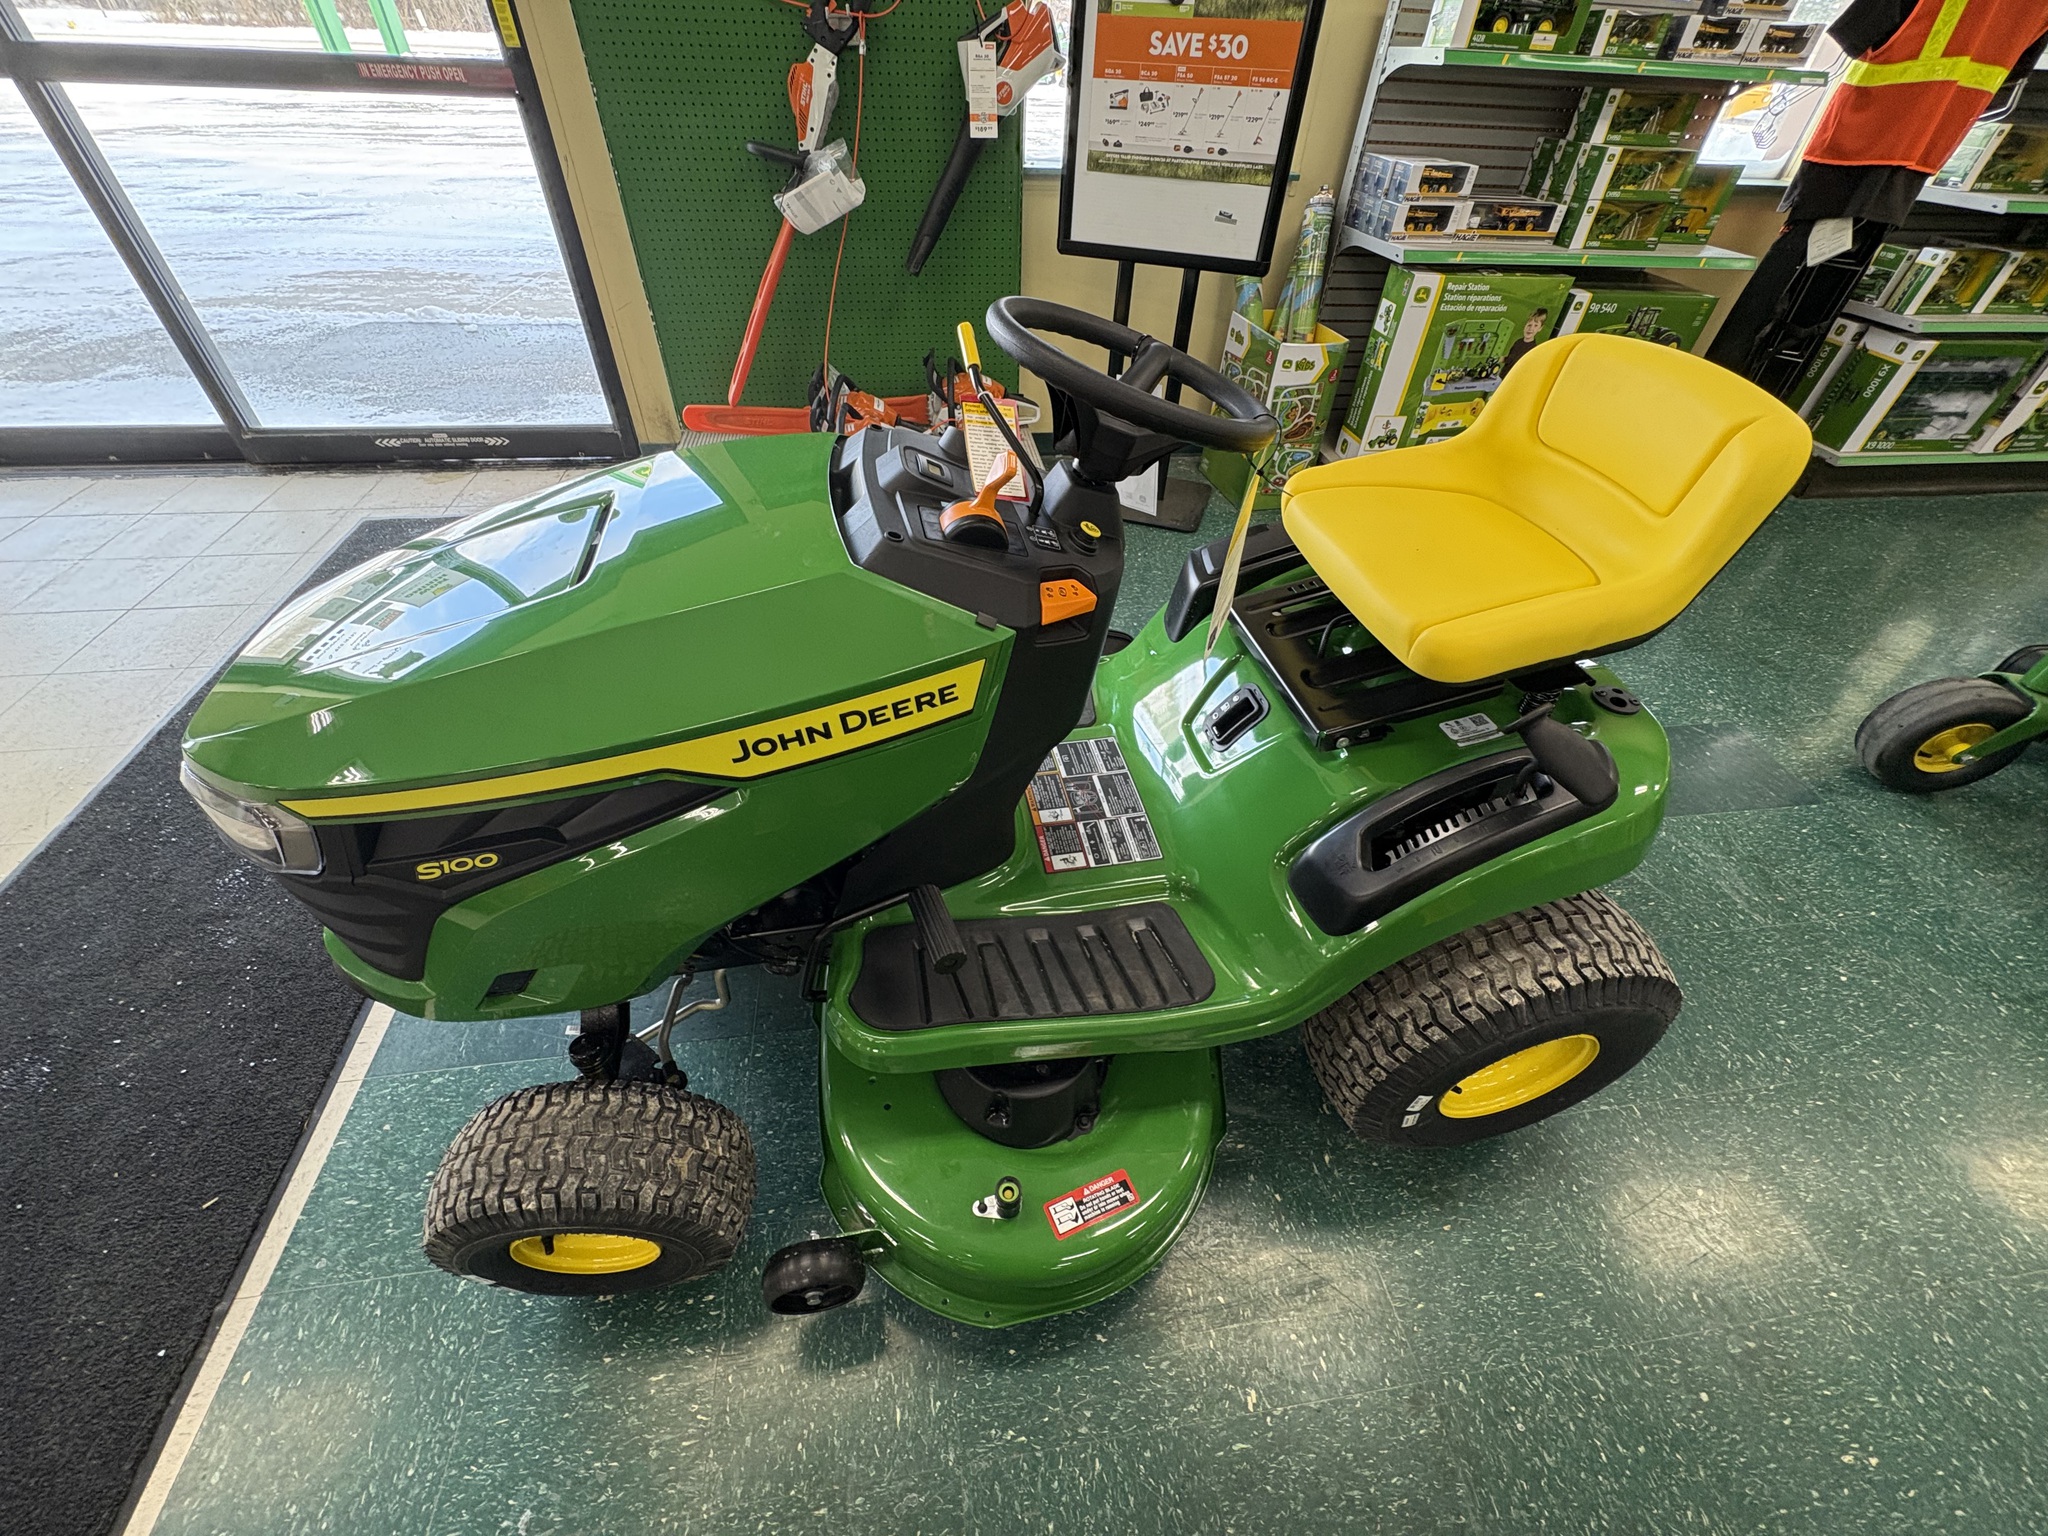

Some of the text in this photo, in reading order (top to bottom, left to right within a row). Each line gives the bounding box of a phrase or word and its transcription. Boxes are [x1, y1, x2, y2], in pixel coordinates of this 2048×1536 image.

[1149, 30, 1249, 60] SAVE $30
[358, 63, 466, 83] IN EMERGENCY PUSH OPEN
[800, 82, 808, 107] STIHL
[1453, 233, 1478, 241] HAGIE
[1446, 282, 1490, 292] Repair Station
[1443, 292, 1502, 304] Station réparations
[1440, 303, 1508, 313] Estación de reparación
[1600, 303, 1618, 314] 540
[1807, 357, 1823, 378] 1000
[1862, 363, 1892, 398] X9 1000
[1864, 441, 1896, 450] X9 1000
[732, 683, 960, 764] JOHN DEERE
[416, 853, 499, 880] S100
[1088, 1176, 1114, 1192] DANGER
